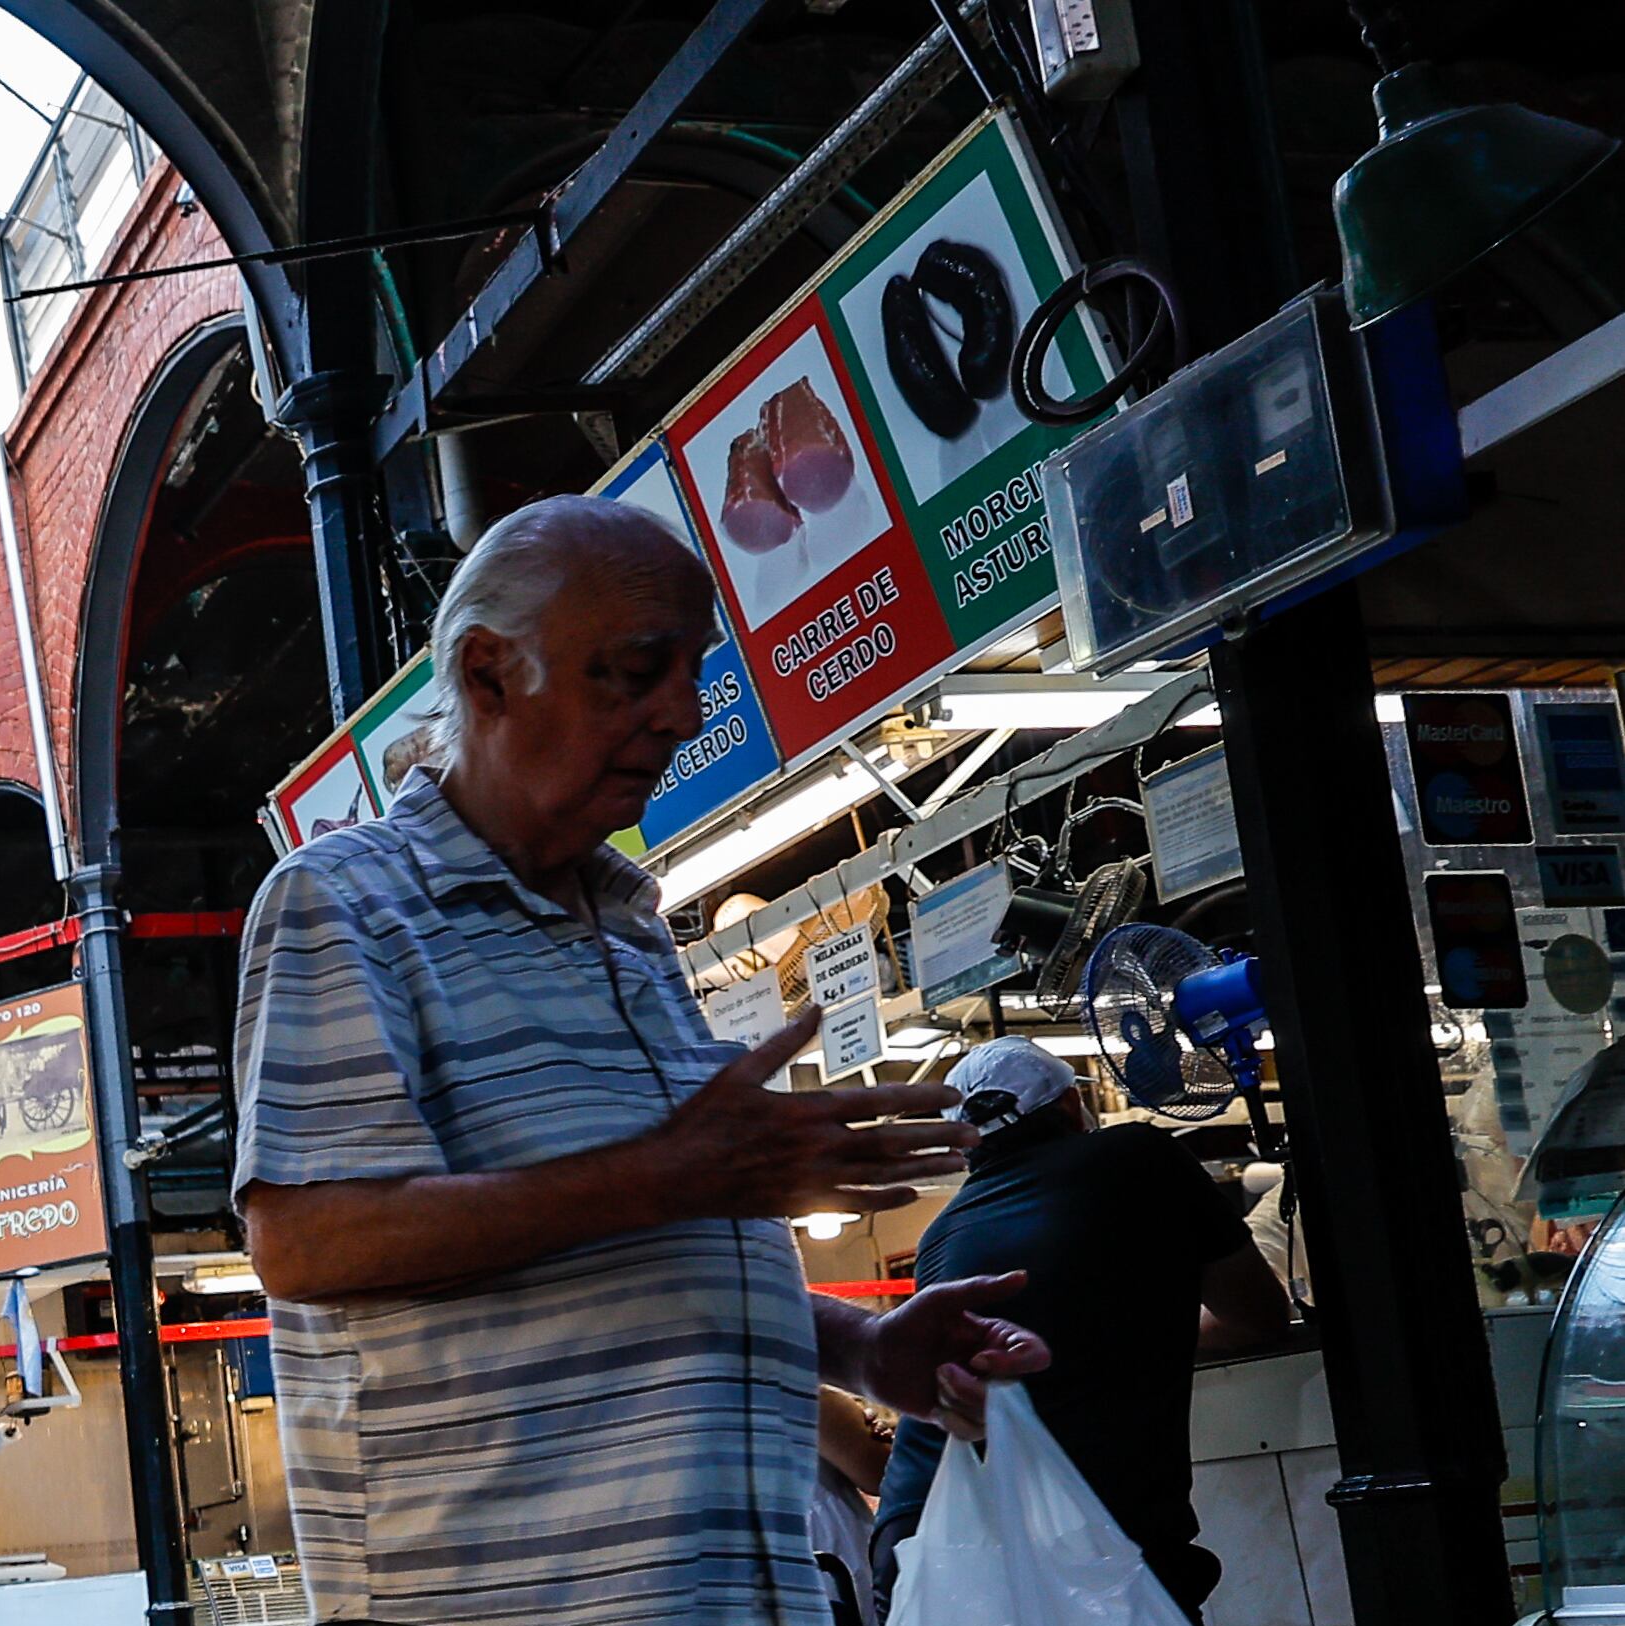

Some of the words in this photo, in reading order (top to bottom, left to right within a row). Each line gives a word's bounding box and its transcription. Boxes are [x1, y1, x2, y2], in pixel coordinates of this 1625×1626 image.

[772, 595, 859, 677] CARRE
[854, 565, 900, 619] DE
[806, 622, 896, 702] CERDO
[698, 671, 741, 721] SAS
[675, 714, 748, 781] CERDO
[1416, 723, 1504, 743] MasterCard
[1436, 796, 1513, 815] Maestro
[1549, 861, 1611, 886] VISA
[16, 1002, 42, 1018] 120
